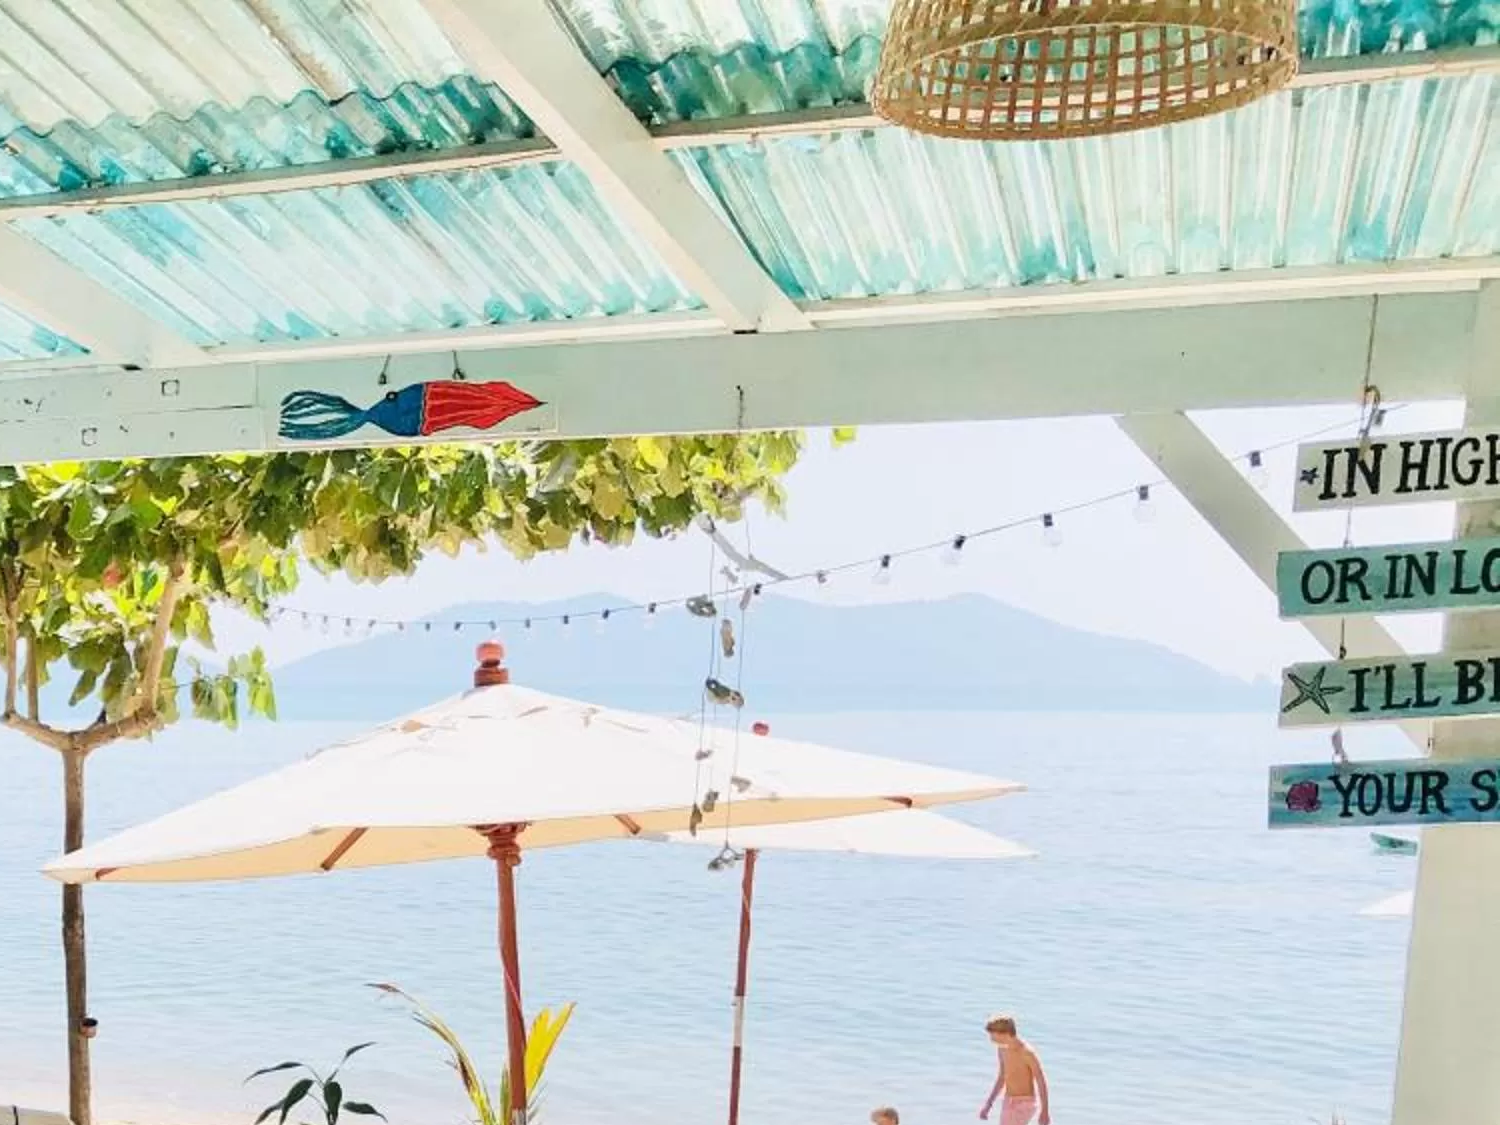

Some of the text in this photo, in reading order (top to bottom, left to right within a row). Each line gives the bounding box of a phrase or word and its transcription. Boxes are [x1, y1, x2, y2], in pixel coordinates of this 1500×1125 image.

[1318, 443, 1387, 500] IN
[1301, 557, 1372, 604] OR
[1384, 551, 1439, 598] IN
[1348, 660, 1441, 713] I'LL
[1328, 769, 1452, 818] YOUR
